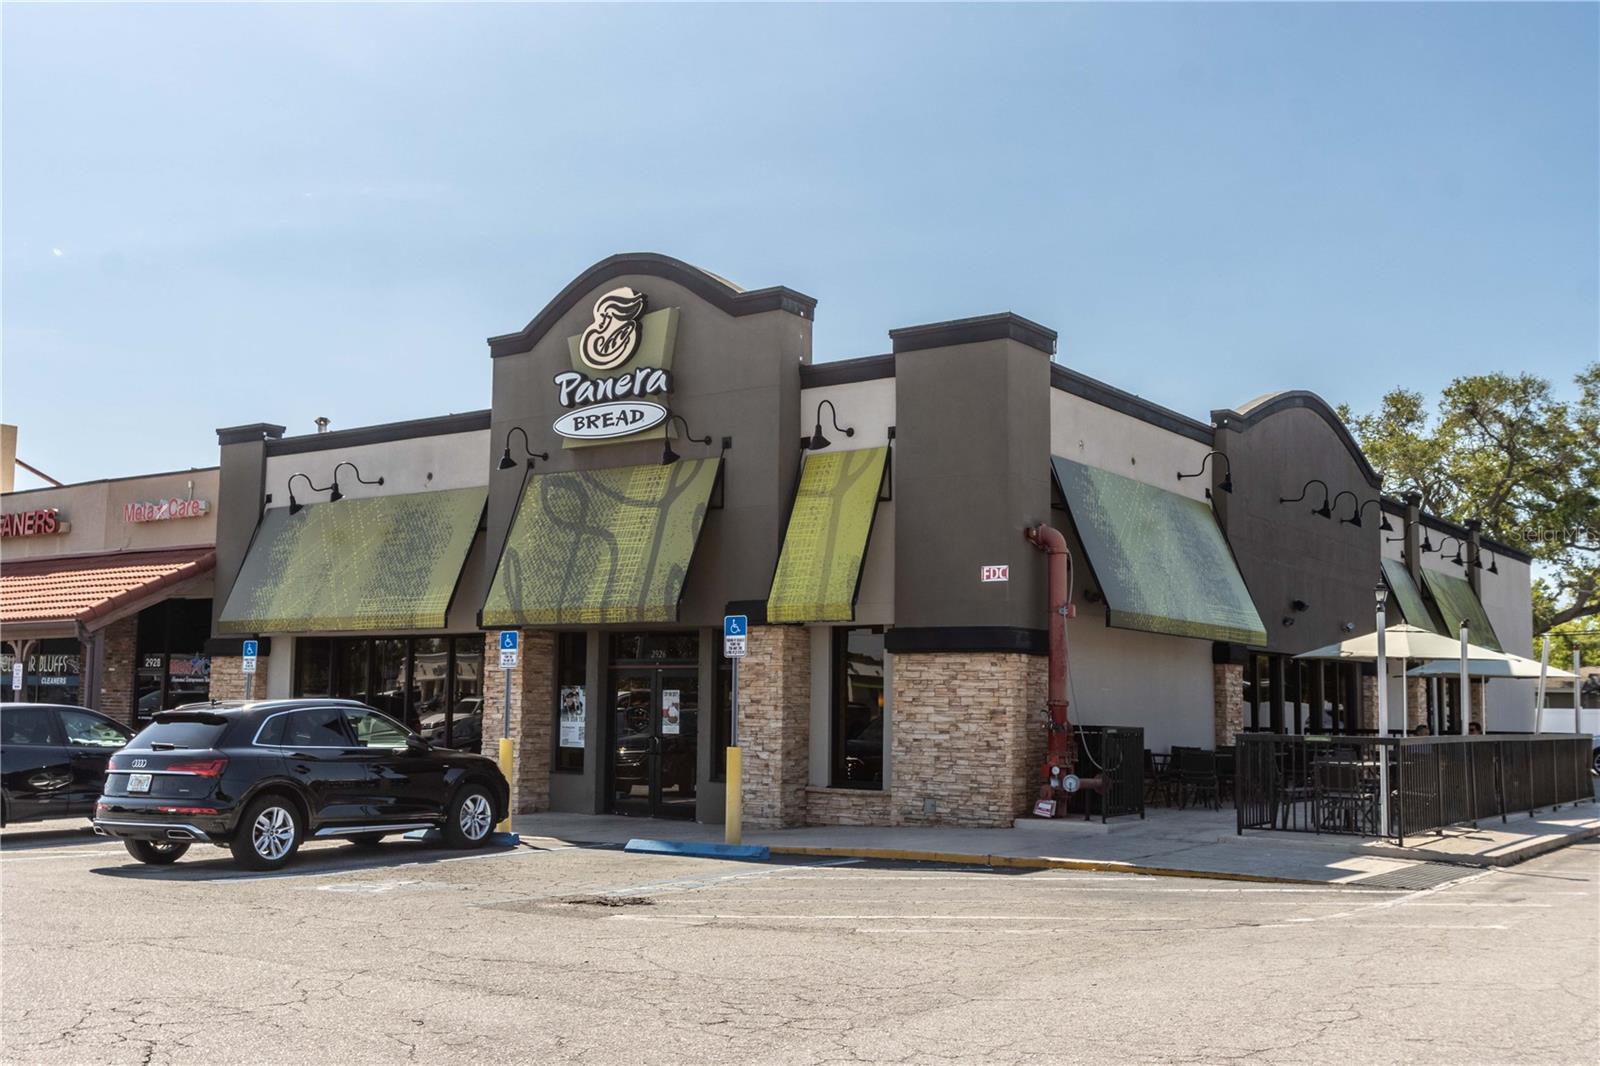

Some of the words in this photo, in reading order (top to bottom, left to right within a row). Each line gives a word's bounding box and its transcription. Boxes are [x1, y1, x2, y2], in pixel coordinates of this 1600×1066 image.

[554, 367, 668, 406] Panera
[572, 409, 645, 431] BREAD
[124, 503, 154, 522] Meta
[168, 497, 200, 517] Care
[983, 567, 1007, 579] FDC
[39, 655, 68, 672] BLUFFS
[145, 658, 161, 667] 2928
[41, 676, 67, 685] CLEANERS
